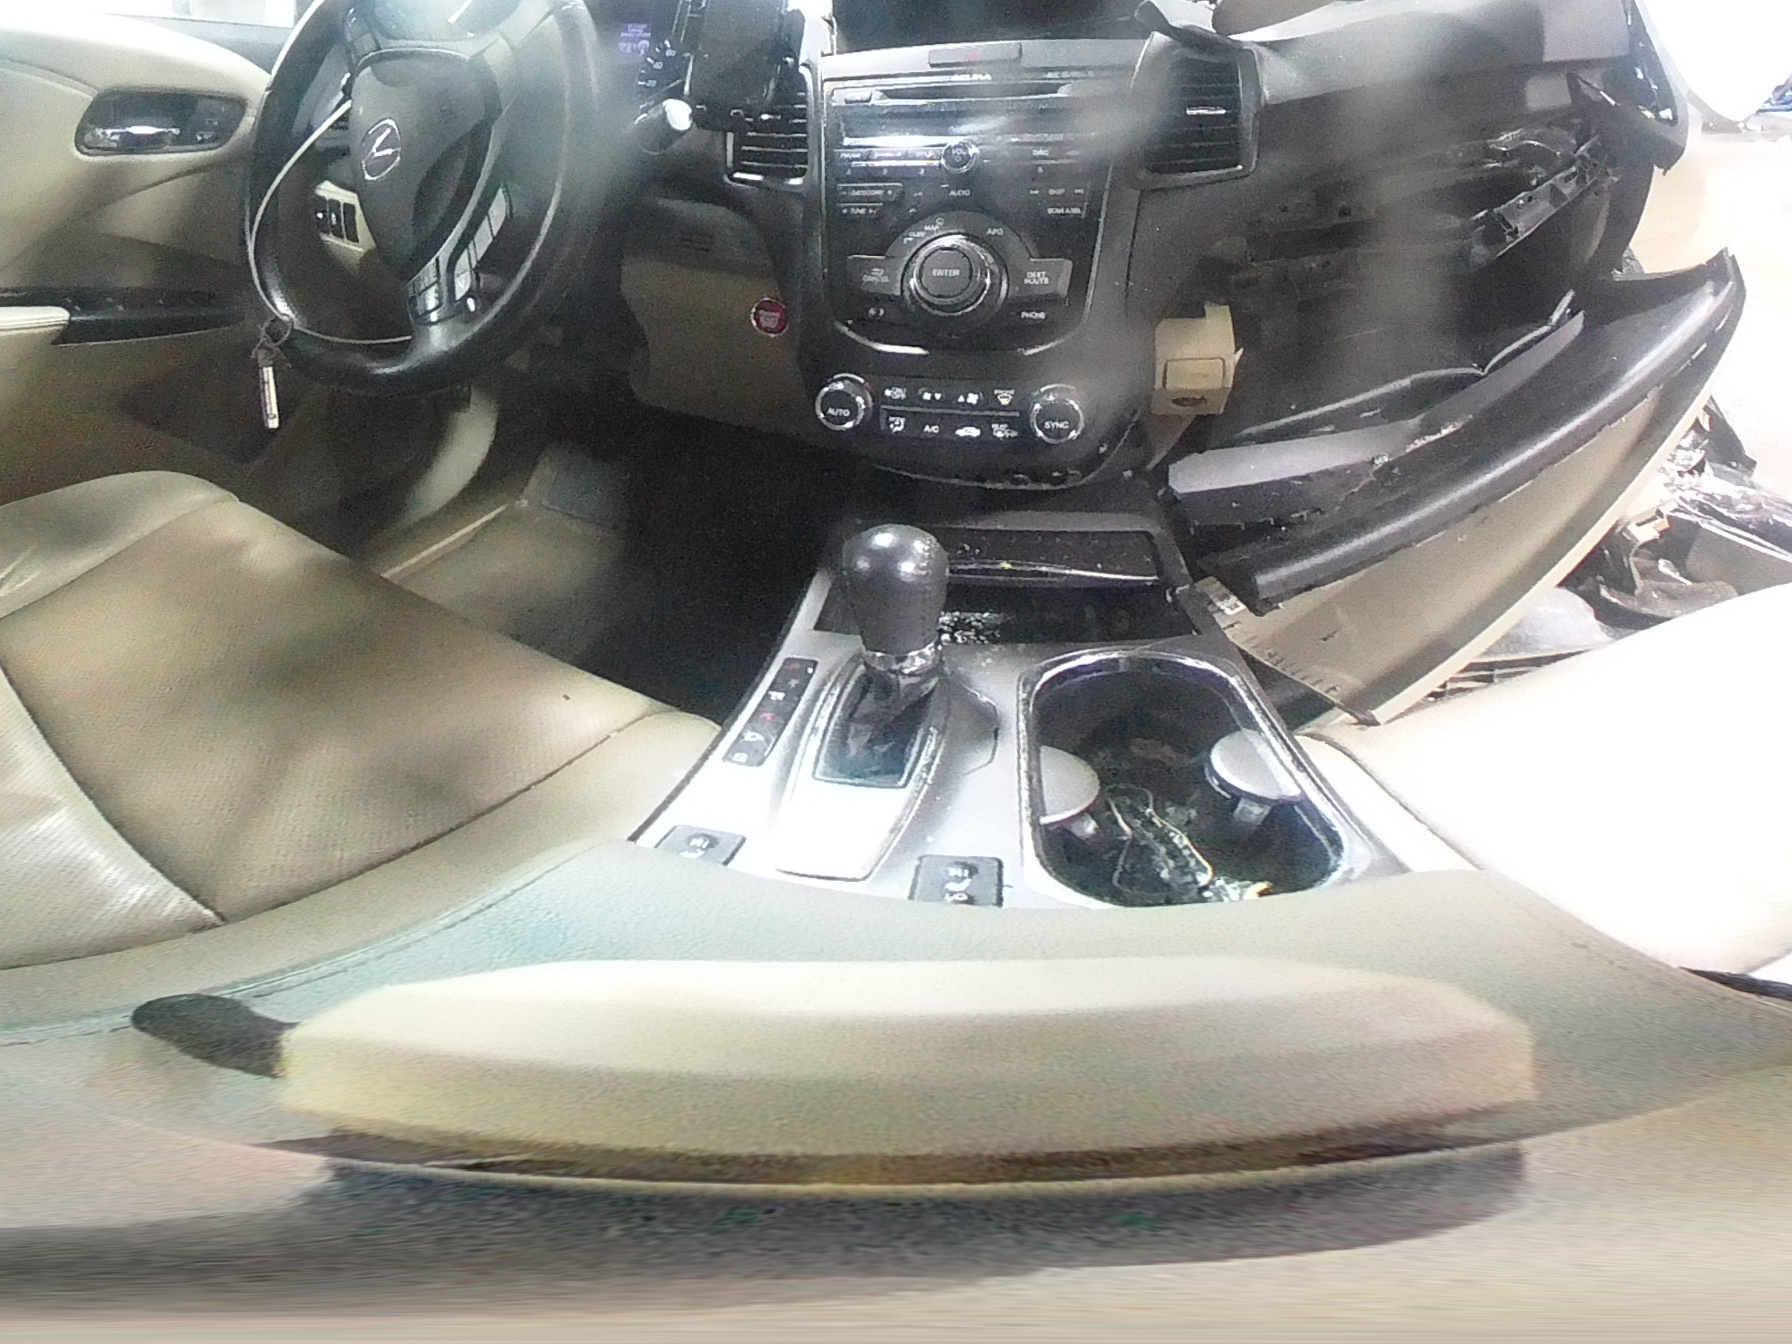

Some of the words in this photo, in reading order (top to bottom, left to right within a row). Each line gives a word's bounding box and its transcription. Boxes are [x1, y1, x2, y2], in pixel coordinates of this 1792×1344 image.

[932, 269, 960, 277] ENTER
[1020, 311, 1046, 320] PHONE
[826, 406, 851, 417] AUTO
[1044, 420, 1069, 430] SYNC
